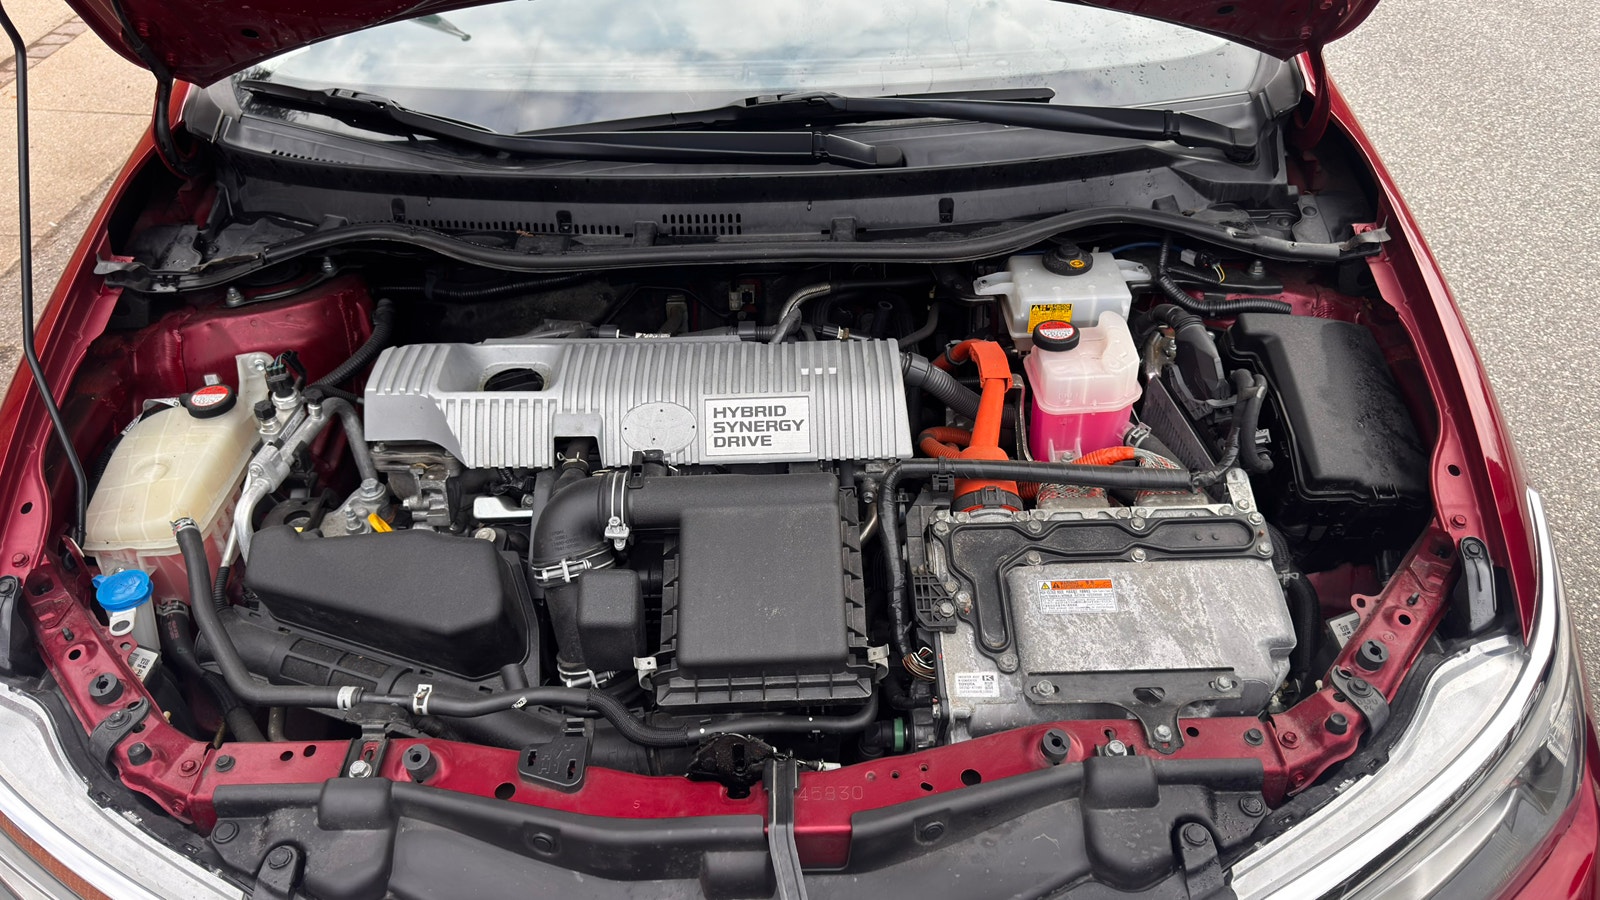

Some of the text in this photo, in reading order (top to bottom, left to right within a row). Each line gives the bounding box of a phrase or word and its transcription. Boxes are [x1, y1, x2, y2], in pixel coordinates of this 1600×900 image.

[713, 405, 787, 419] HYBRID
[713, 419, 805, 434] SYNERGY
[713, 435, 772, 448] DRIVE
[798, 785, 864, 801] 45830
